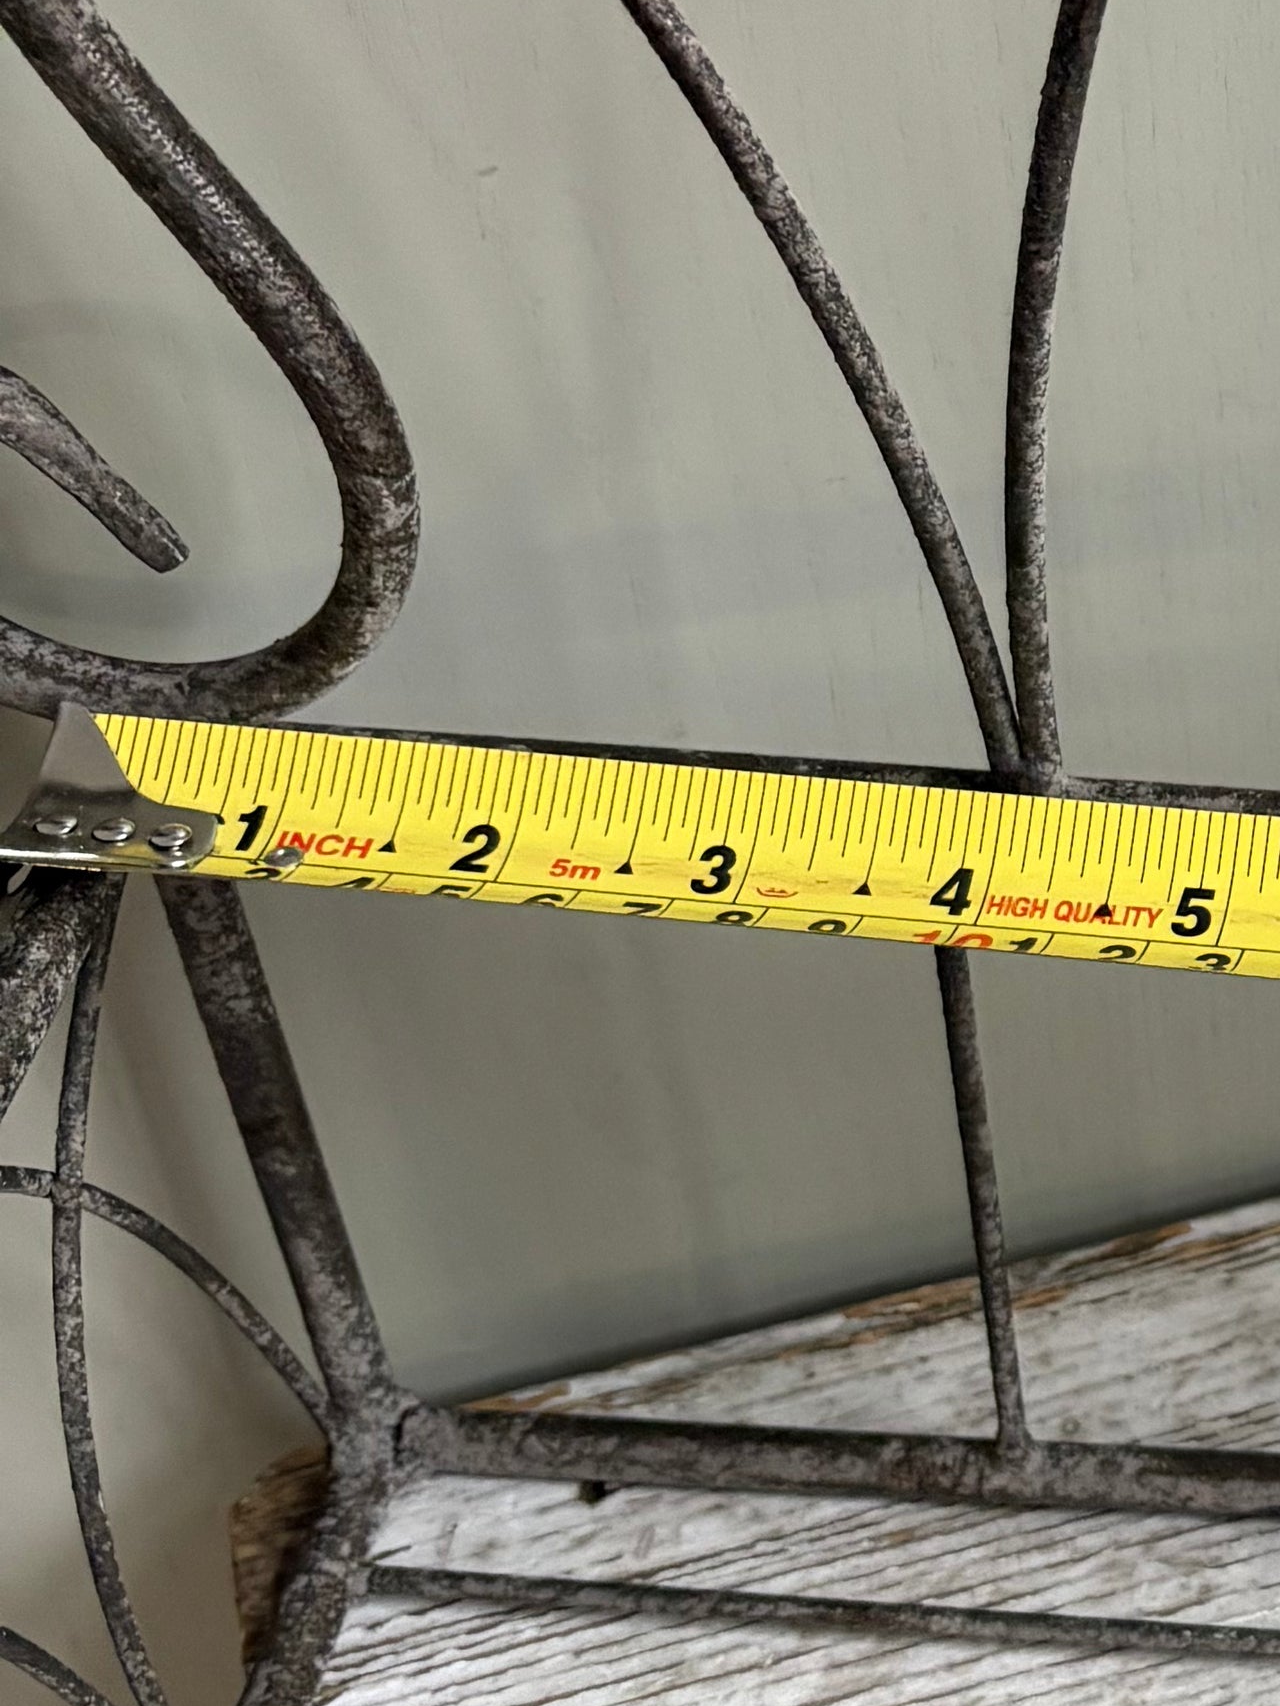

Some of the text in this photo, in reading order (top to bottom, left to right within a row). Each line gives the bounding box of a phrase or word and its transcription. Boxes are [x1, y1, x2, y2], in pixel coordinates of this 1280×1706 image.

[276, 831, 375, 859] INCH
[235, 805, 268, 851] 1
[449, 824, 500, 873] 2
[690, 845, 737, 894] 3
[930, 868, 974, 916] 4
[1171, 887, 1216, 937] 5
[549, 858, 601, 881] 5m
[986, 894, 1165, 929] HIGH QUALITY
